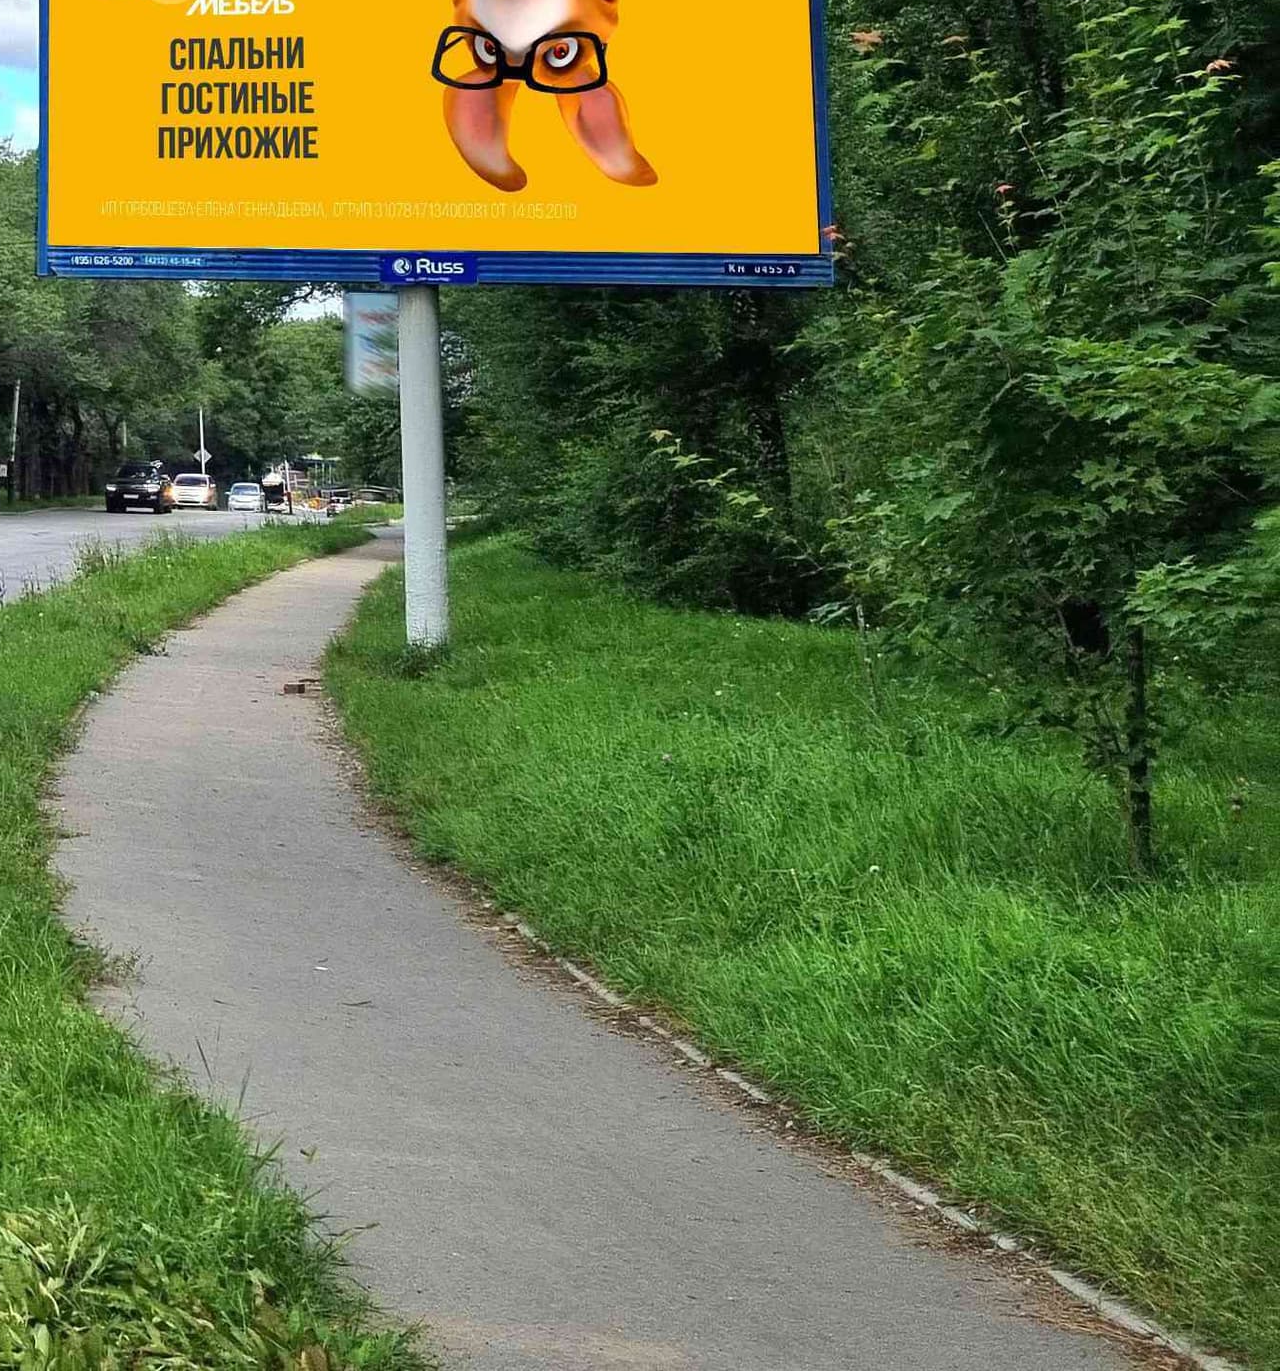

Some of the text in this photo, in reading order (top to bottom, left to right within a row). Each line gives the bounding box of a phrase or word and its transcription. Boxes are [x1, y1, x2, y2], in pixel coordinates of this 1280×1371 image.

[169, 36, 305, 70] СПАЛЬНИ
[161, 81, 315, 115] ГОСТИНЫЕ
[157, 125, 319, 159] ПРИХОЖИЕ
[333, 201, 372, 218] ОГРИП
[490, 202, 507, 219] ОТ
[93, 255, 134, 266] 626-5200
[415, 257, 465, 274] Russ
